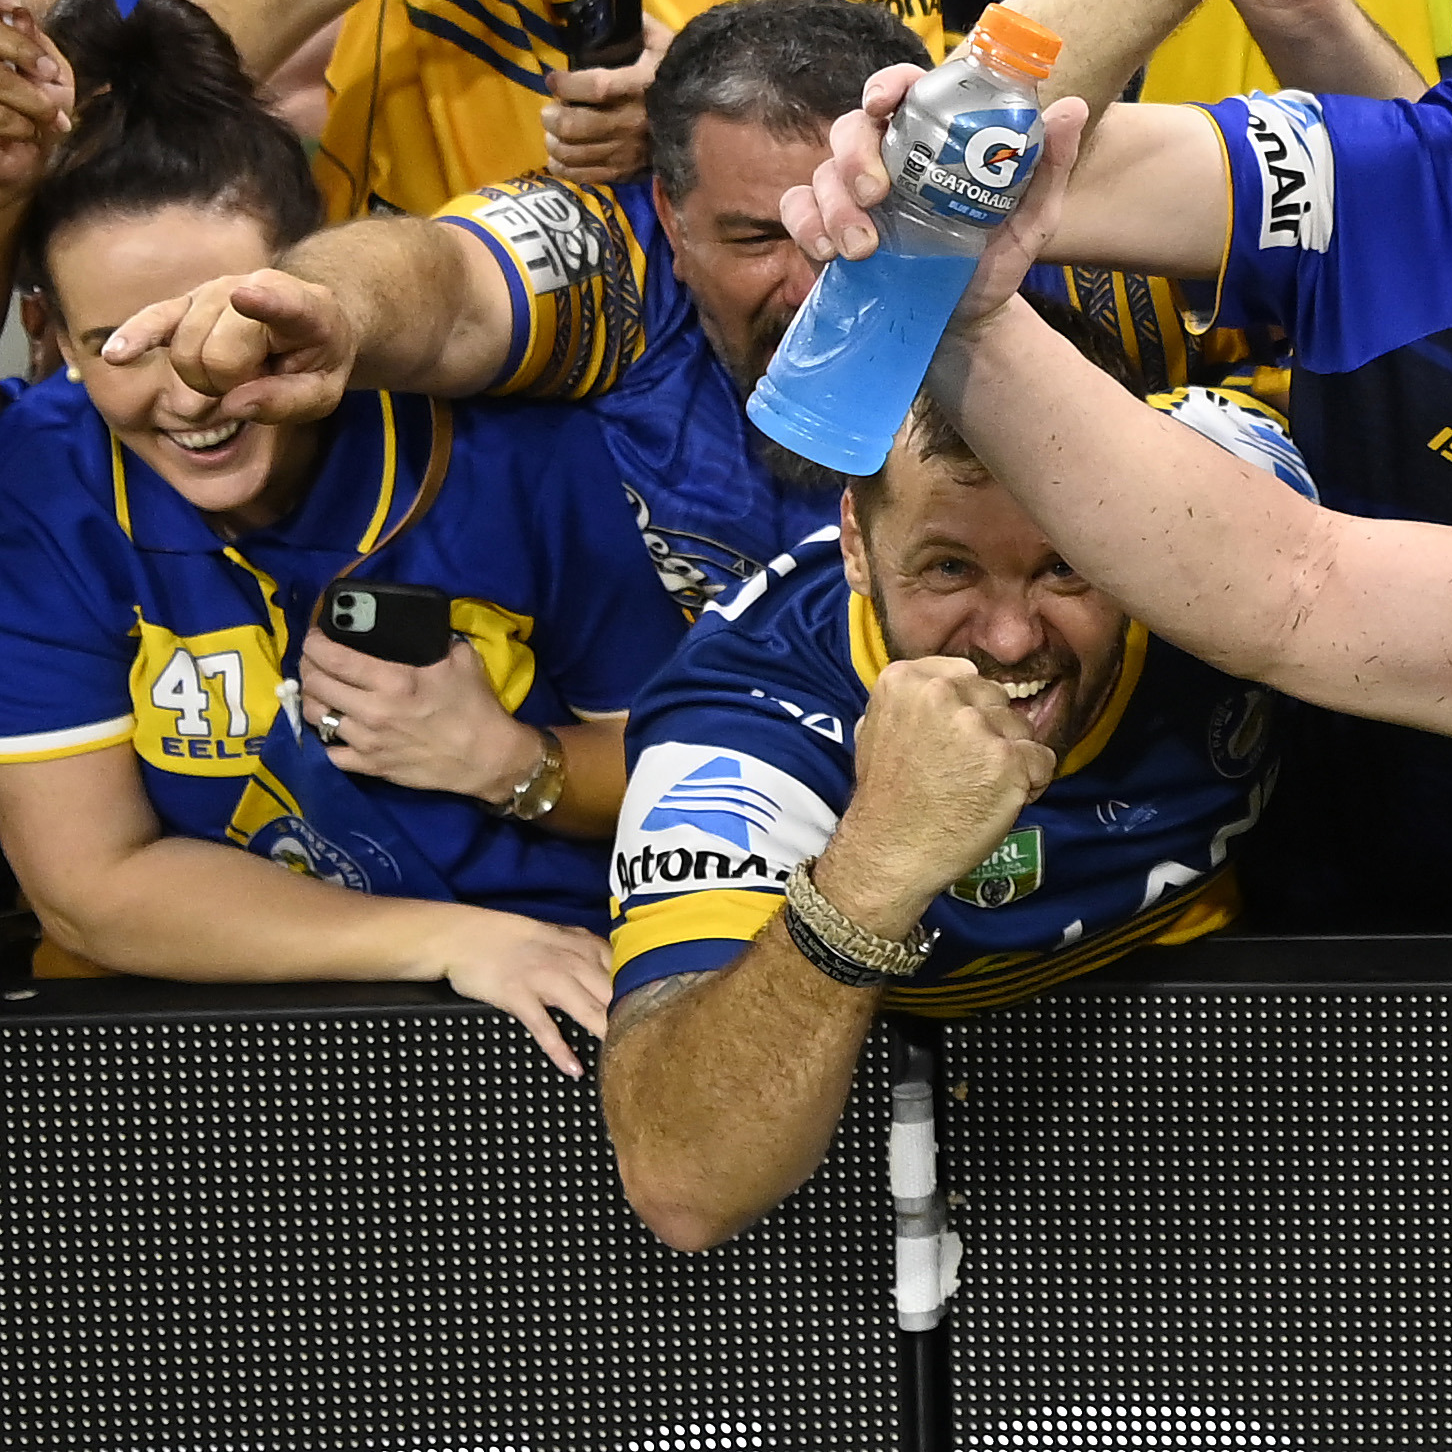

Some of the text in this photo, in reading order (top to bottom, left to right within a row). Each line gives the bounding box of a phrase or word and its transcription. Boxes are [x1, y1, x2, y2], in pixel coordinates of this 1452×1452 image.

[930, 166, 1016, 211] GATORADE
[948, 200, 971, 215] BLUE
[484, 203, 560, 278] FIT
[150, 648, 250, 737] 47
[161, 735, 269, 760] EELS
